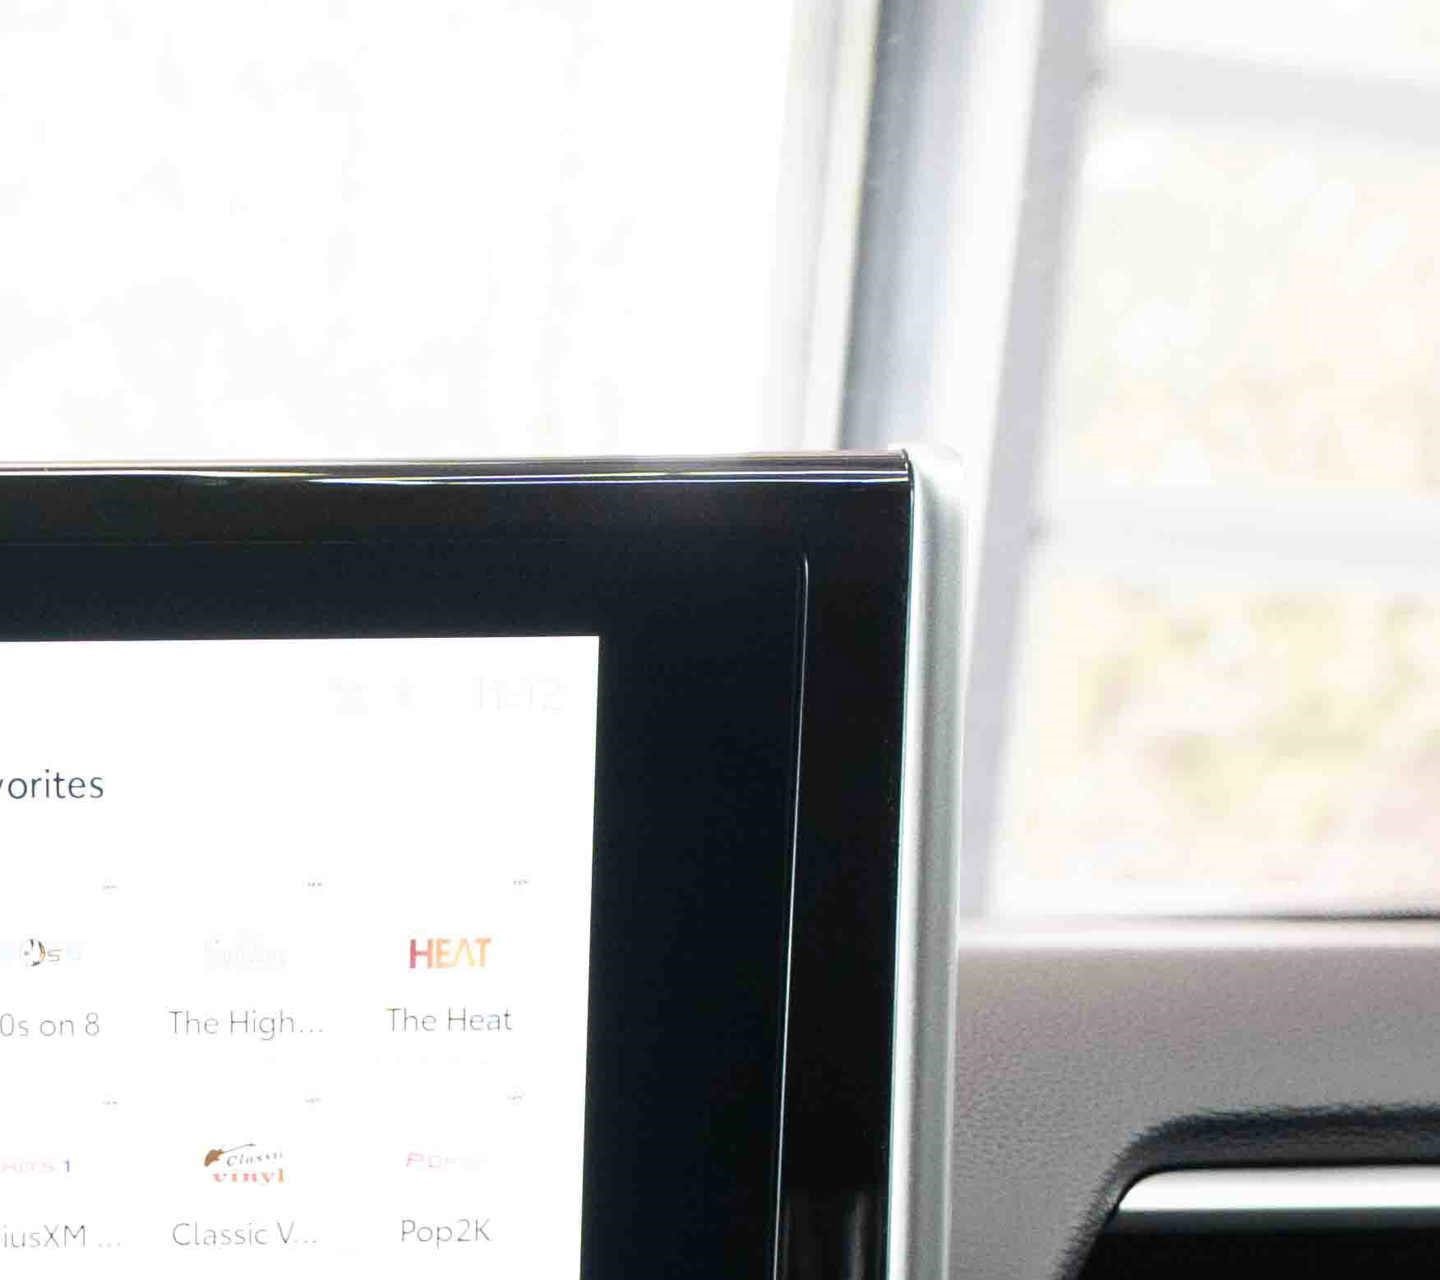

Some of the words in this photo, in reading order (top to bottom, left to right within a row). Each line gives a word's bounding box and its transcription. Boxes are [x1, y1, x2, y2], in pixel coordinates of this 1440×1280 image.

[408, 937, 492, 970] HEAT
[39, 1018, 75, 1038] on
[83, 1011, 101, 1037] 8
[168, 1010, 220, 1035] The
[385, 1007, 437, 1033] The
[447, 1006, 513, 1033] Heat
[172, 1218, 268, 1247] Classic
[401, 1217, 491, 1249] Pop2K
